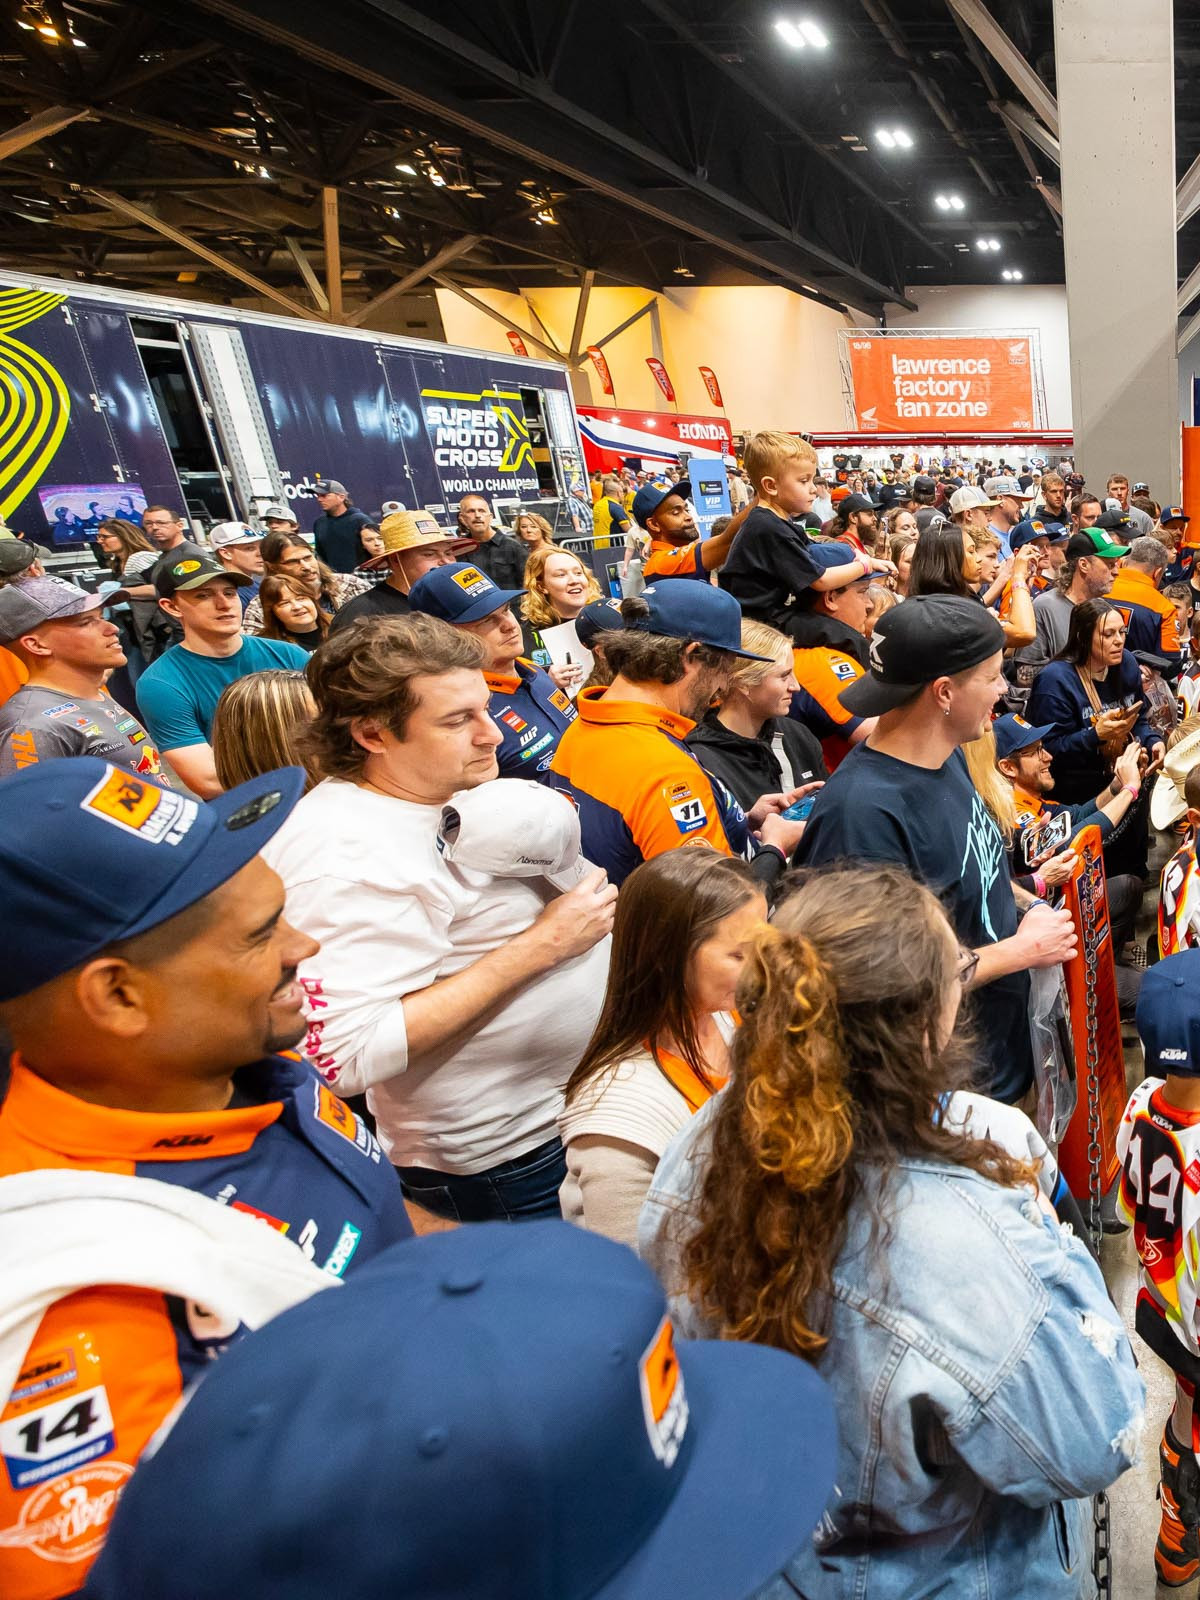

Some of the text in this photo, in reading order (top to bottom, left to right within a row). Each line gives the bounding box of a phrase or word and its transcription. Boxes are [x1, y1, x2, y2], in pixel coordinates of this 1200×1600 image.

[892, 354, 991, 375] lawrence
[893, 376, 971, 400] factory
[895, 397, 988, 417] fan zone
[426, 406, 498, 428] SUPER
[436, 429, 498, 447] MOTO
[677, 423, 729, 441] HONDA
[435, 449, 503, 467] CROSS
[442, 479, 484, 493] WORLD
[704, 497, 721, 505] VIP
[838, 664, 850, 673] 6
[681, 802, 702, 821] 11
[517, 855, 555, 866] Abnormal
[1159, 1049, 1188, 1061] KTM
[1151, 1114, 1174, 1132] KTM
[1125, 1134, 1181, 1225] 14
[18, 1396, 99, 1453] 14
